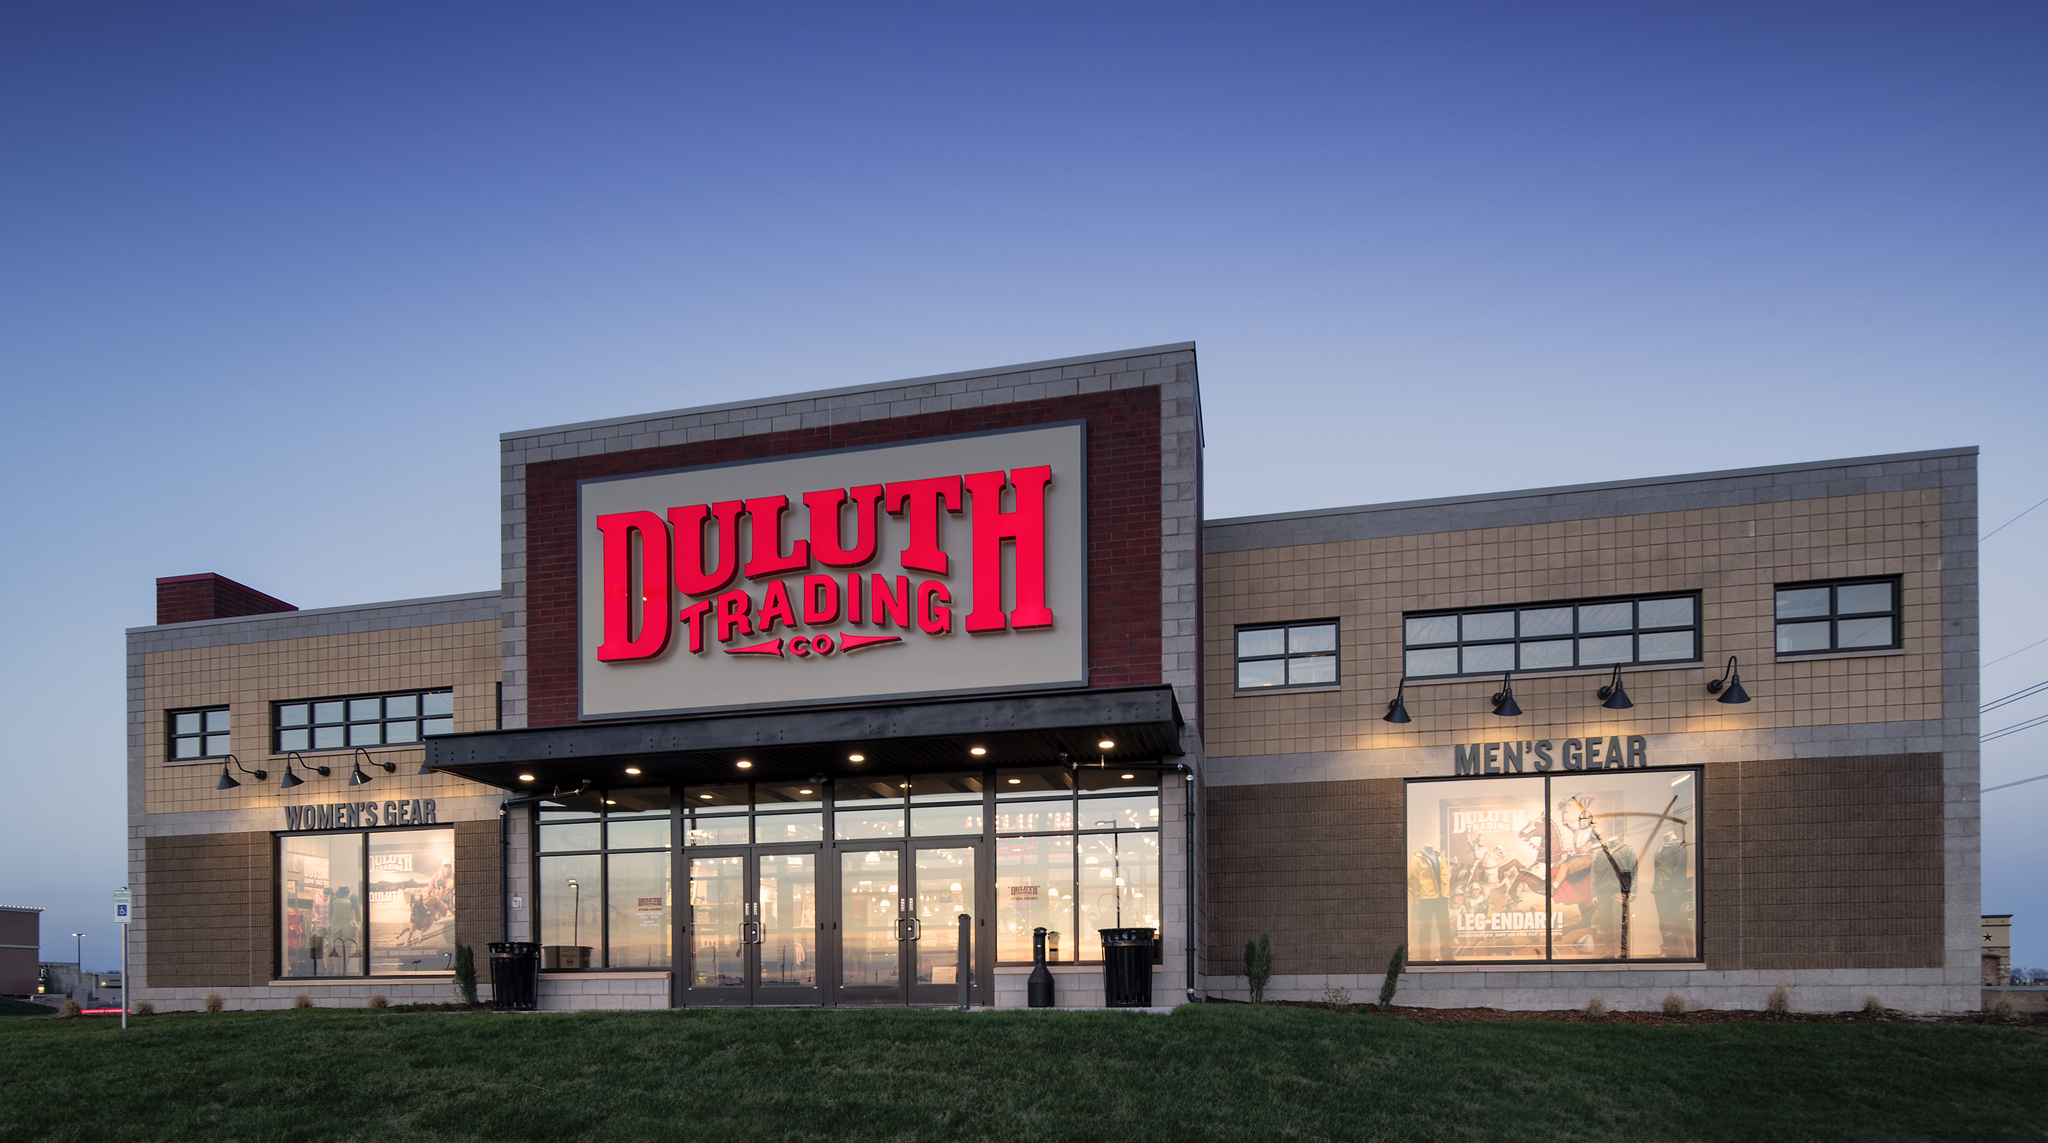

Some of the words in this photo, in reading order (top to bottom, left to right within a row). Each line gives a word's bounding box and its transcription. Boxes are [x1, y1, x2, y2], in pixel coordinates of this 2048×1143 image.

[597, 464, 1053, 662] DULUTH
[680, 573, 952, 654] TRADING
[788, 633, 835, 657] CO
[1455, 739, 1553, 776] MEN'S
[1562, 735, 1647, 771] GEAR
[284, 801, 378, 831] WOMEN'S
[383, 799, 437, 827] GEAR
[1453, 809, 1525, 833] DULUTH
[1466, 821, 1511, 832] TRADING
[1011, 885, 1038, 895] DULUTH
